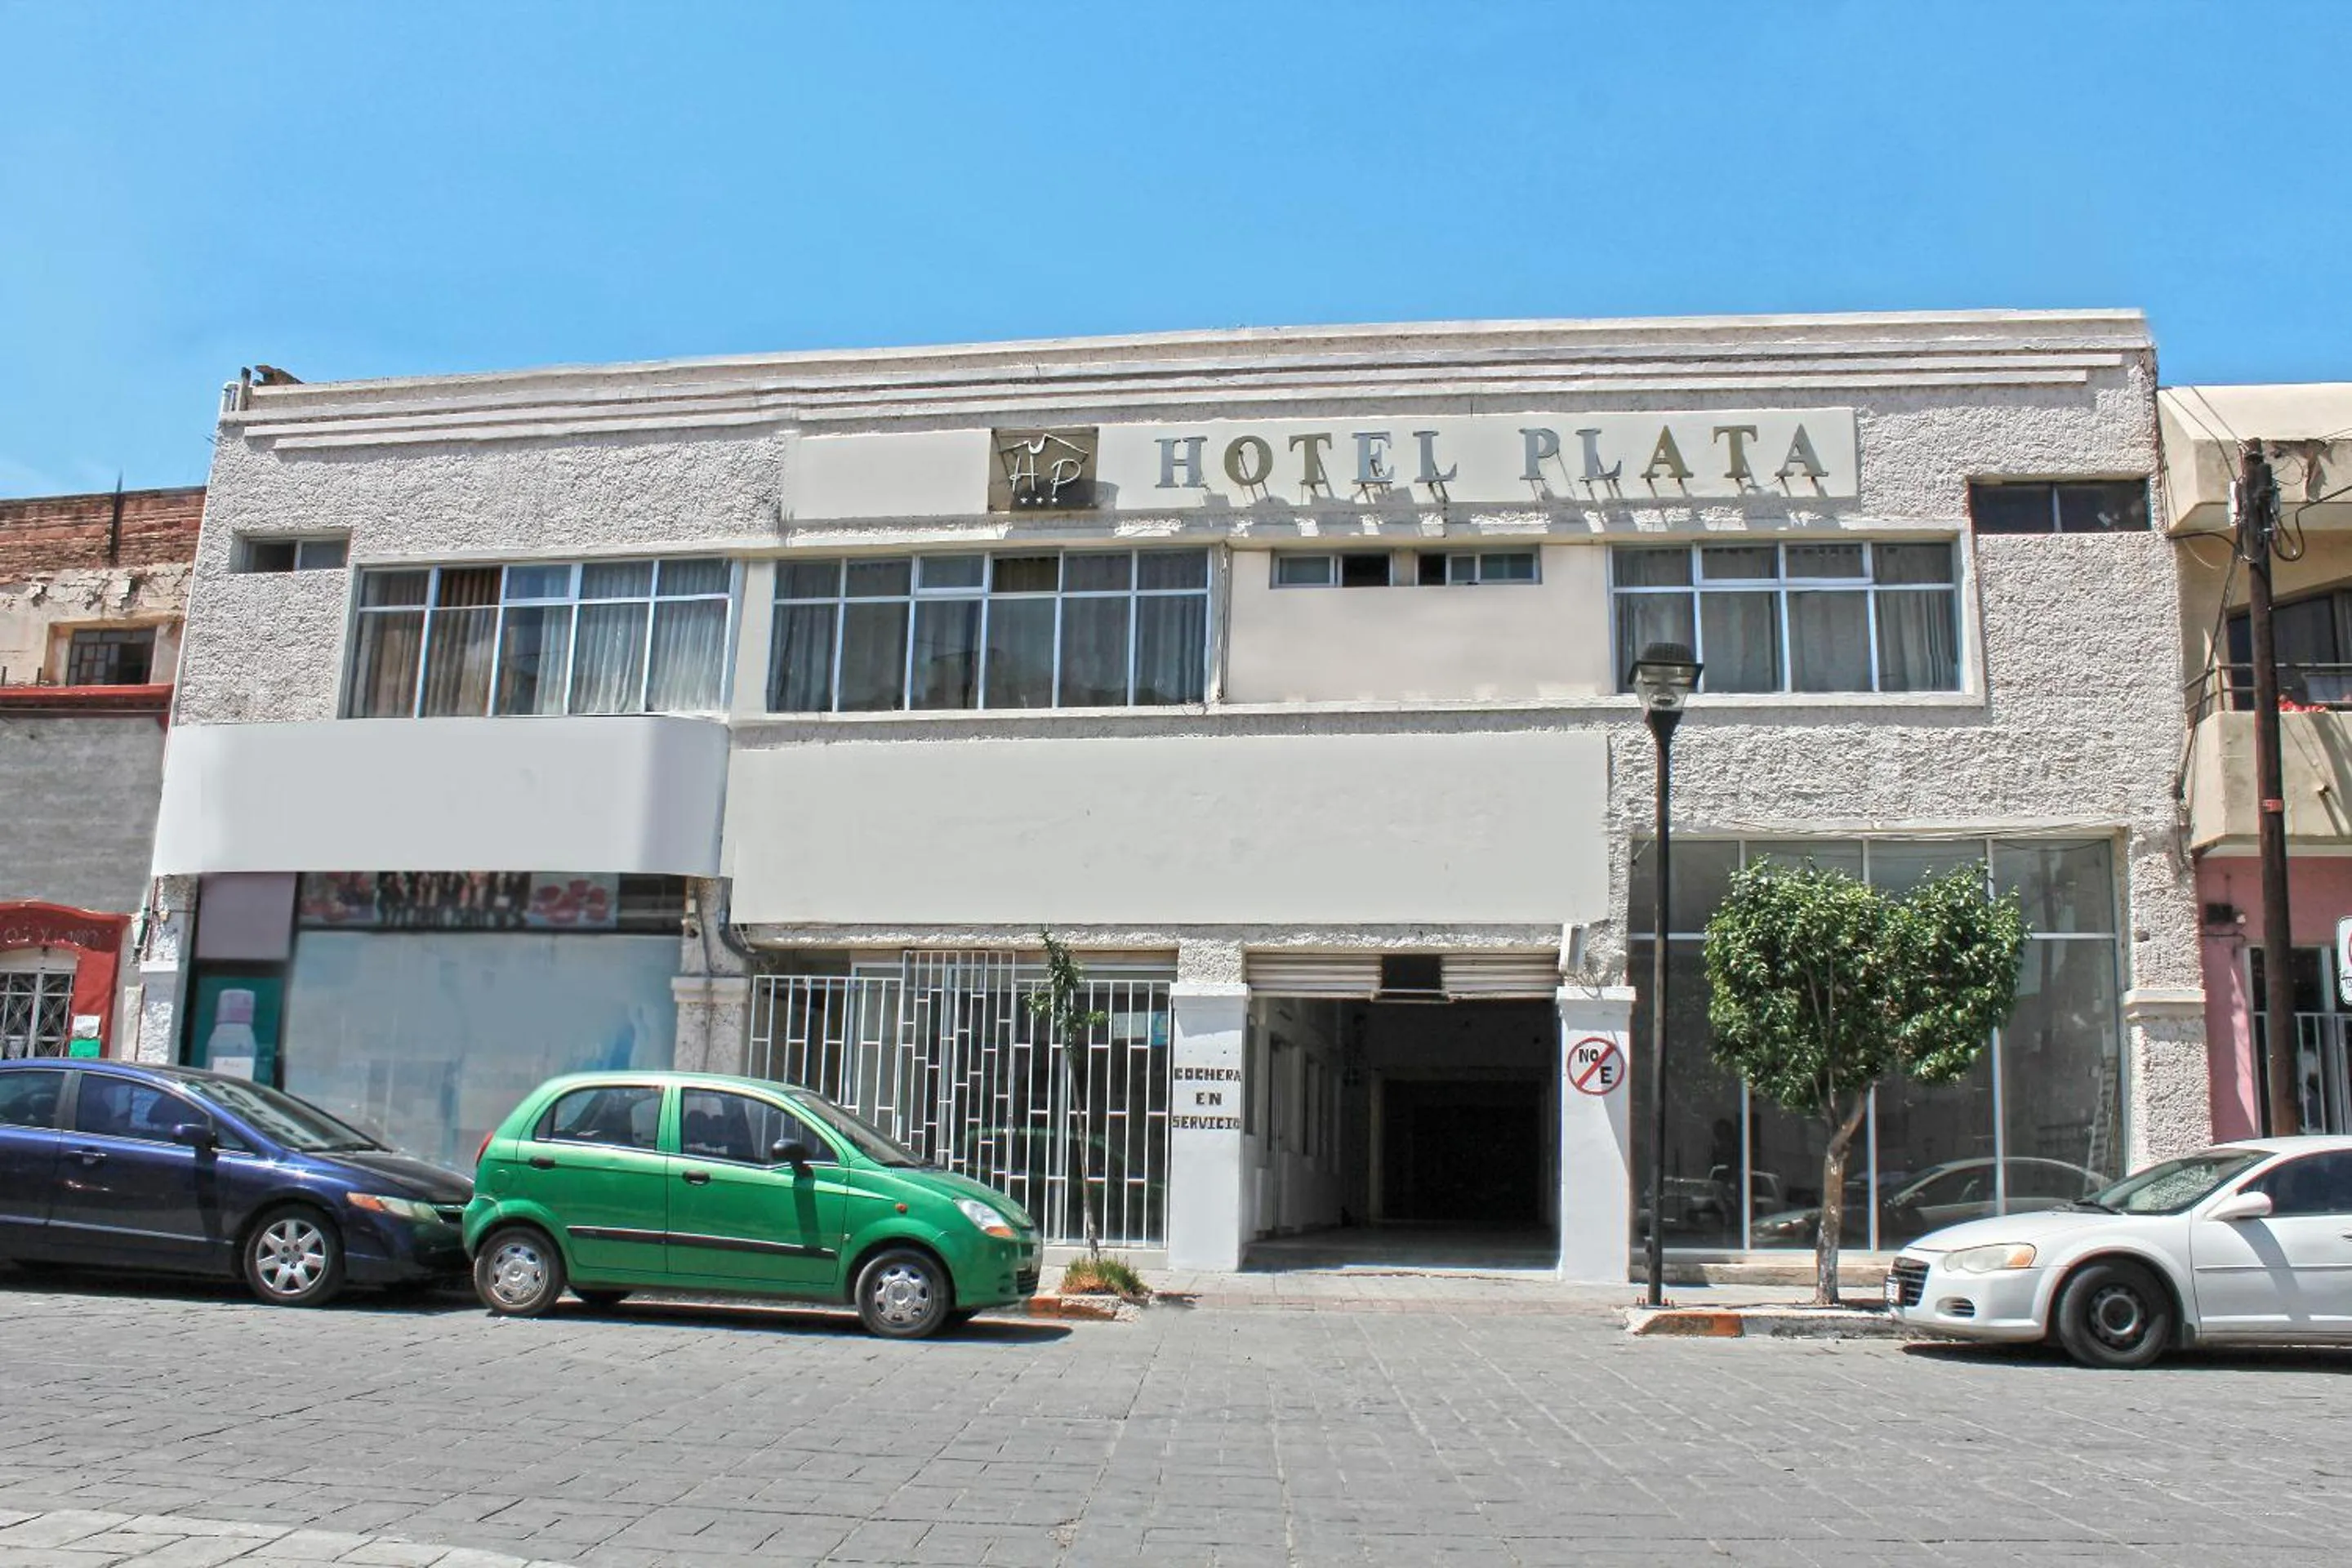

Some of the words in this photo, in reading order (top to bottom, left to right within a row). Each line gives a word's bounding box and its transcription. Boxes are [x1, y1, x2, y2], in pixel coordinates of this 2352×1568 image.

[1154, 431, 1458, 488] HOTEL
[1518, 423, 1830, 480] PLATA
[1579, 1049, 1599, 1062] NO
[1174, 1067, 1241, 1081] COCHERA
[1601, 1066, 1612, 1084] E
[1196, 1092, 1222, 1106] EN
[1172, 1116, 1241, 1129] SERVICIO
